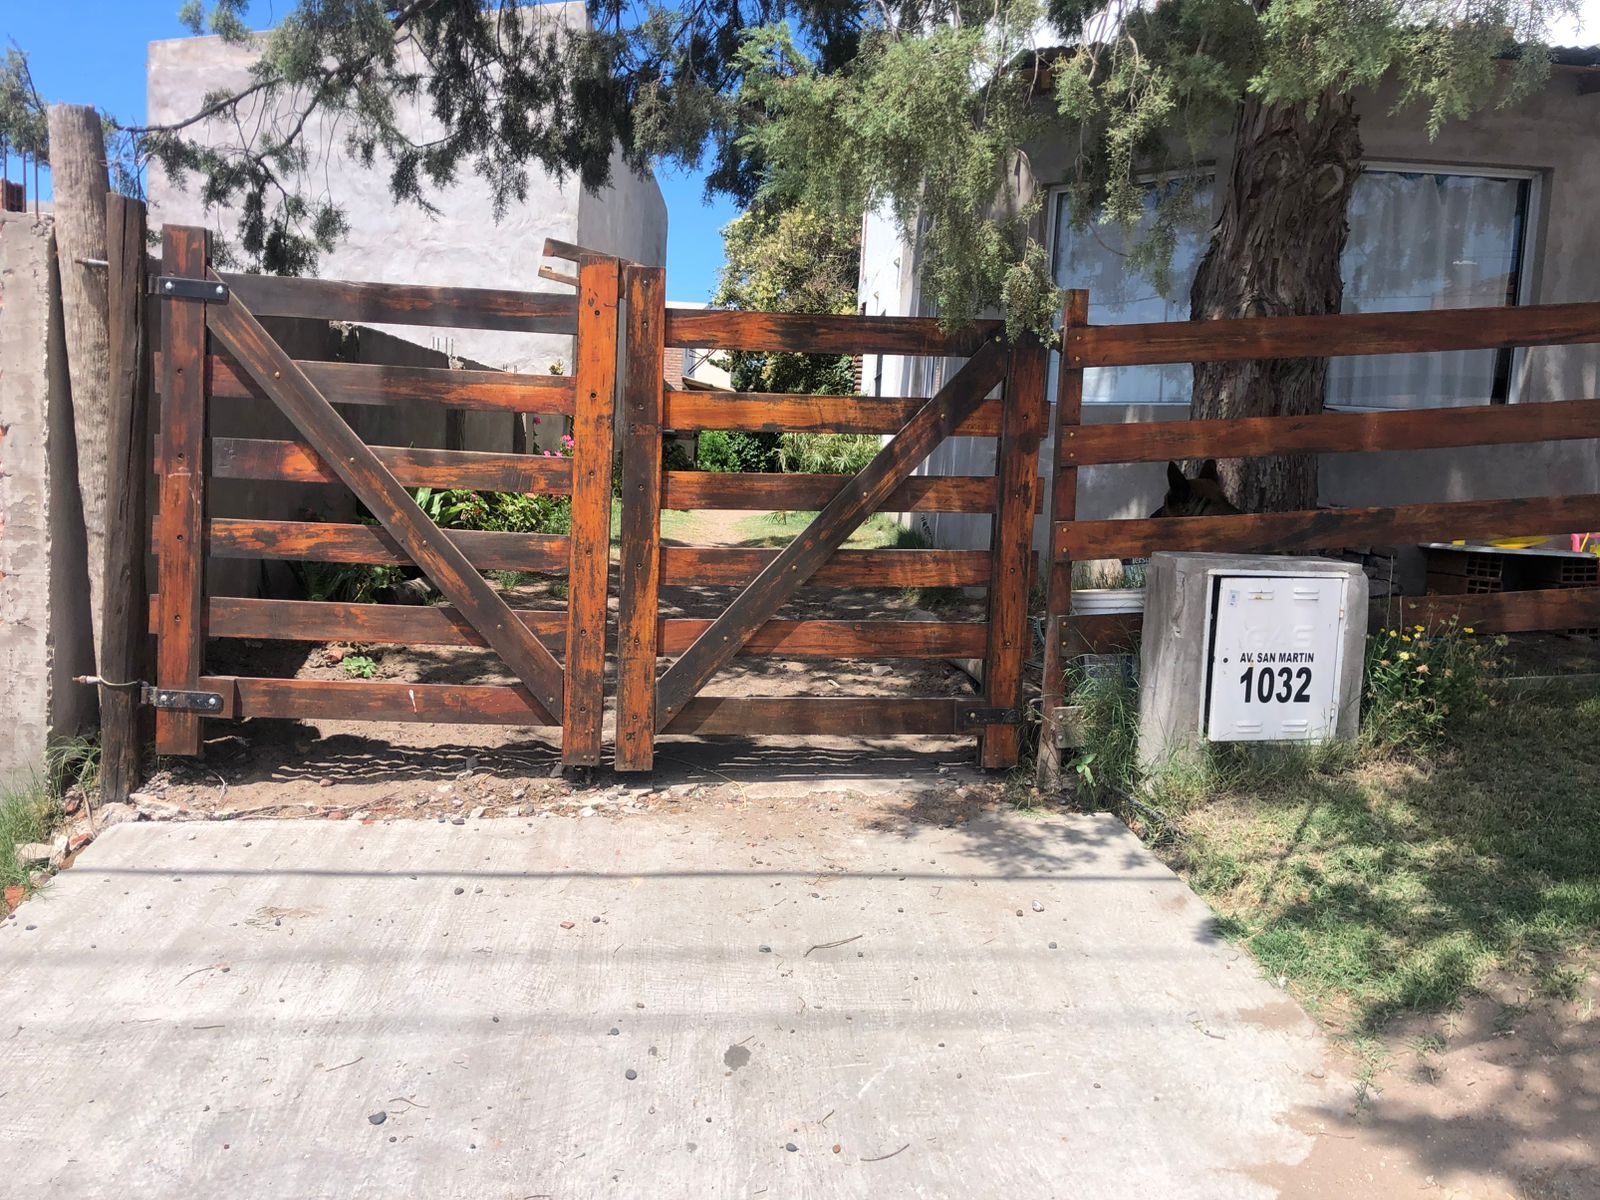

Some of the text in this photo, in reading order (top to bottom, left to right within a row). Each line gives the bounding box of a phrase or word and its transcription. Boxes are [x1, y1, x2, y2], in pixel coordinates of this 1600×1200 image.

[1240, 652, 1315, 663] AV. SAN MARTIN
[1240, 666, 1312, 703] 1032
